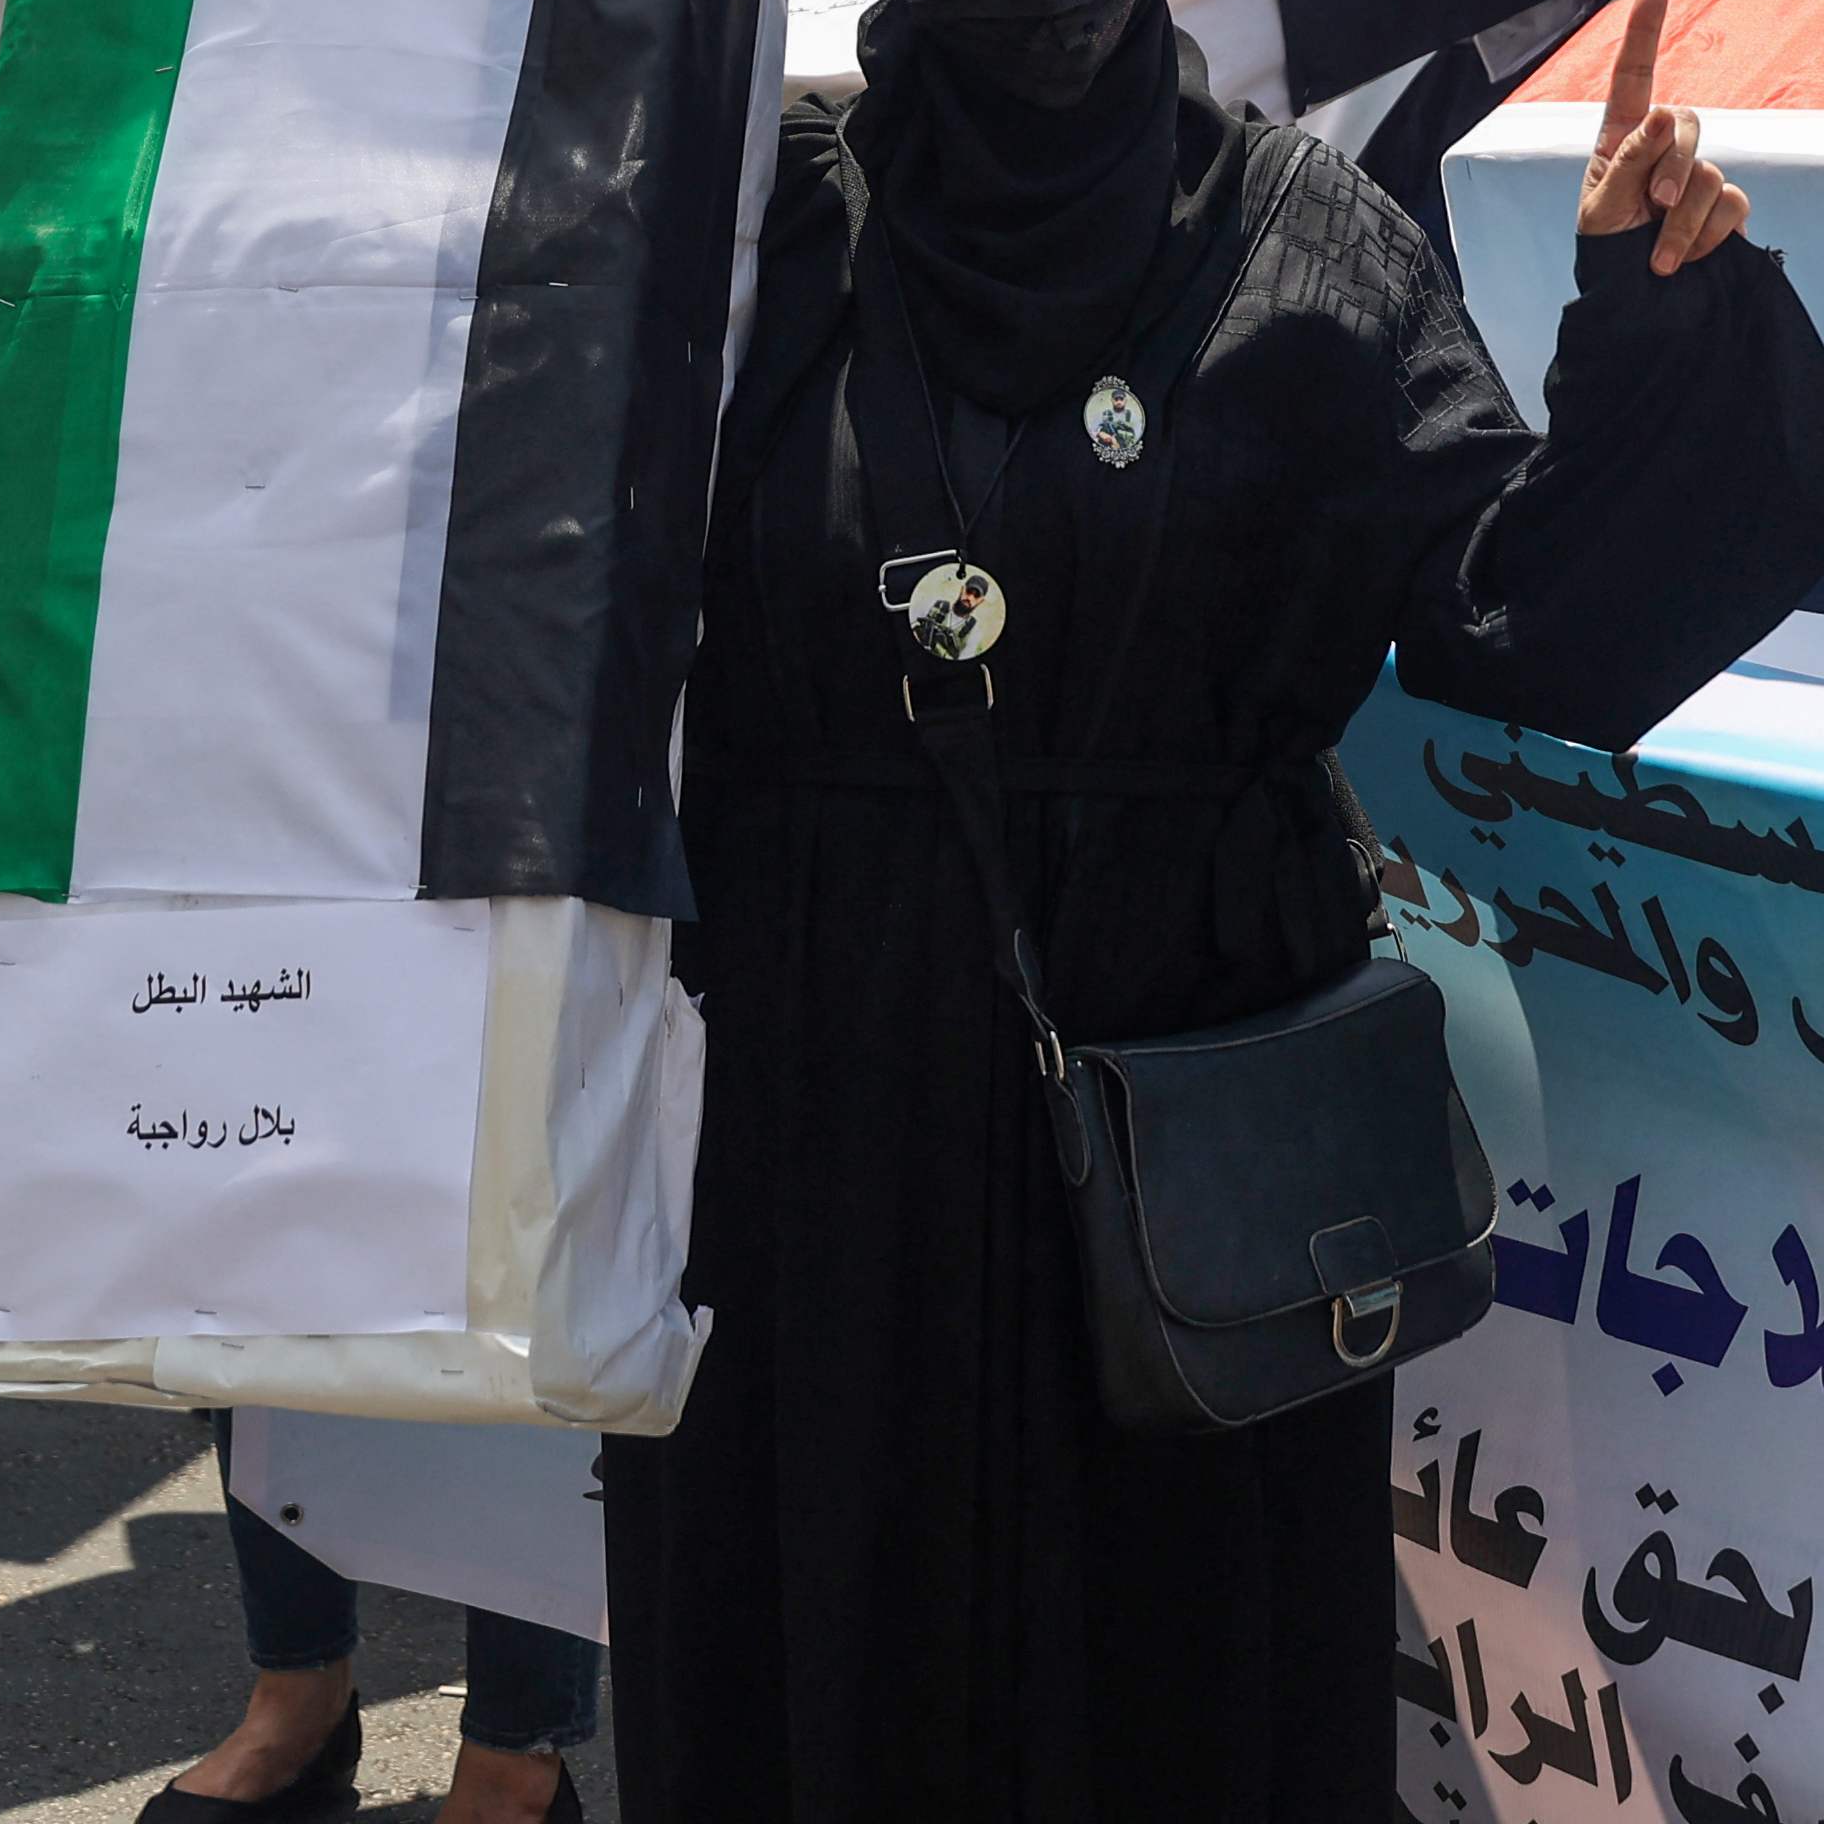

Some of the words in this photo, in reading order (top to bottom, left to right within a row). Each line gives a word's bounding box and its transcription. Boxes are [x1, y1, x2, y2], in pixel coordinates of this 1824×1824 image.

[1380, 833, 1760, 1048] والمحرري
[132, 971, 207, 1013] البطل
[220, 968, 312, 1013] الشهيد
[126, 1102, 227, 1150] رواجبة
[238, 1104, 296, 1146] بلال
[1581, 1482, 1816, 1715] بحق
